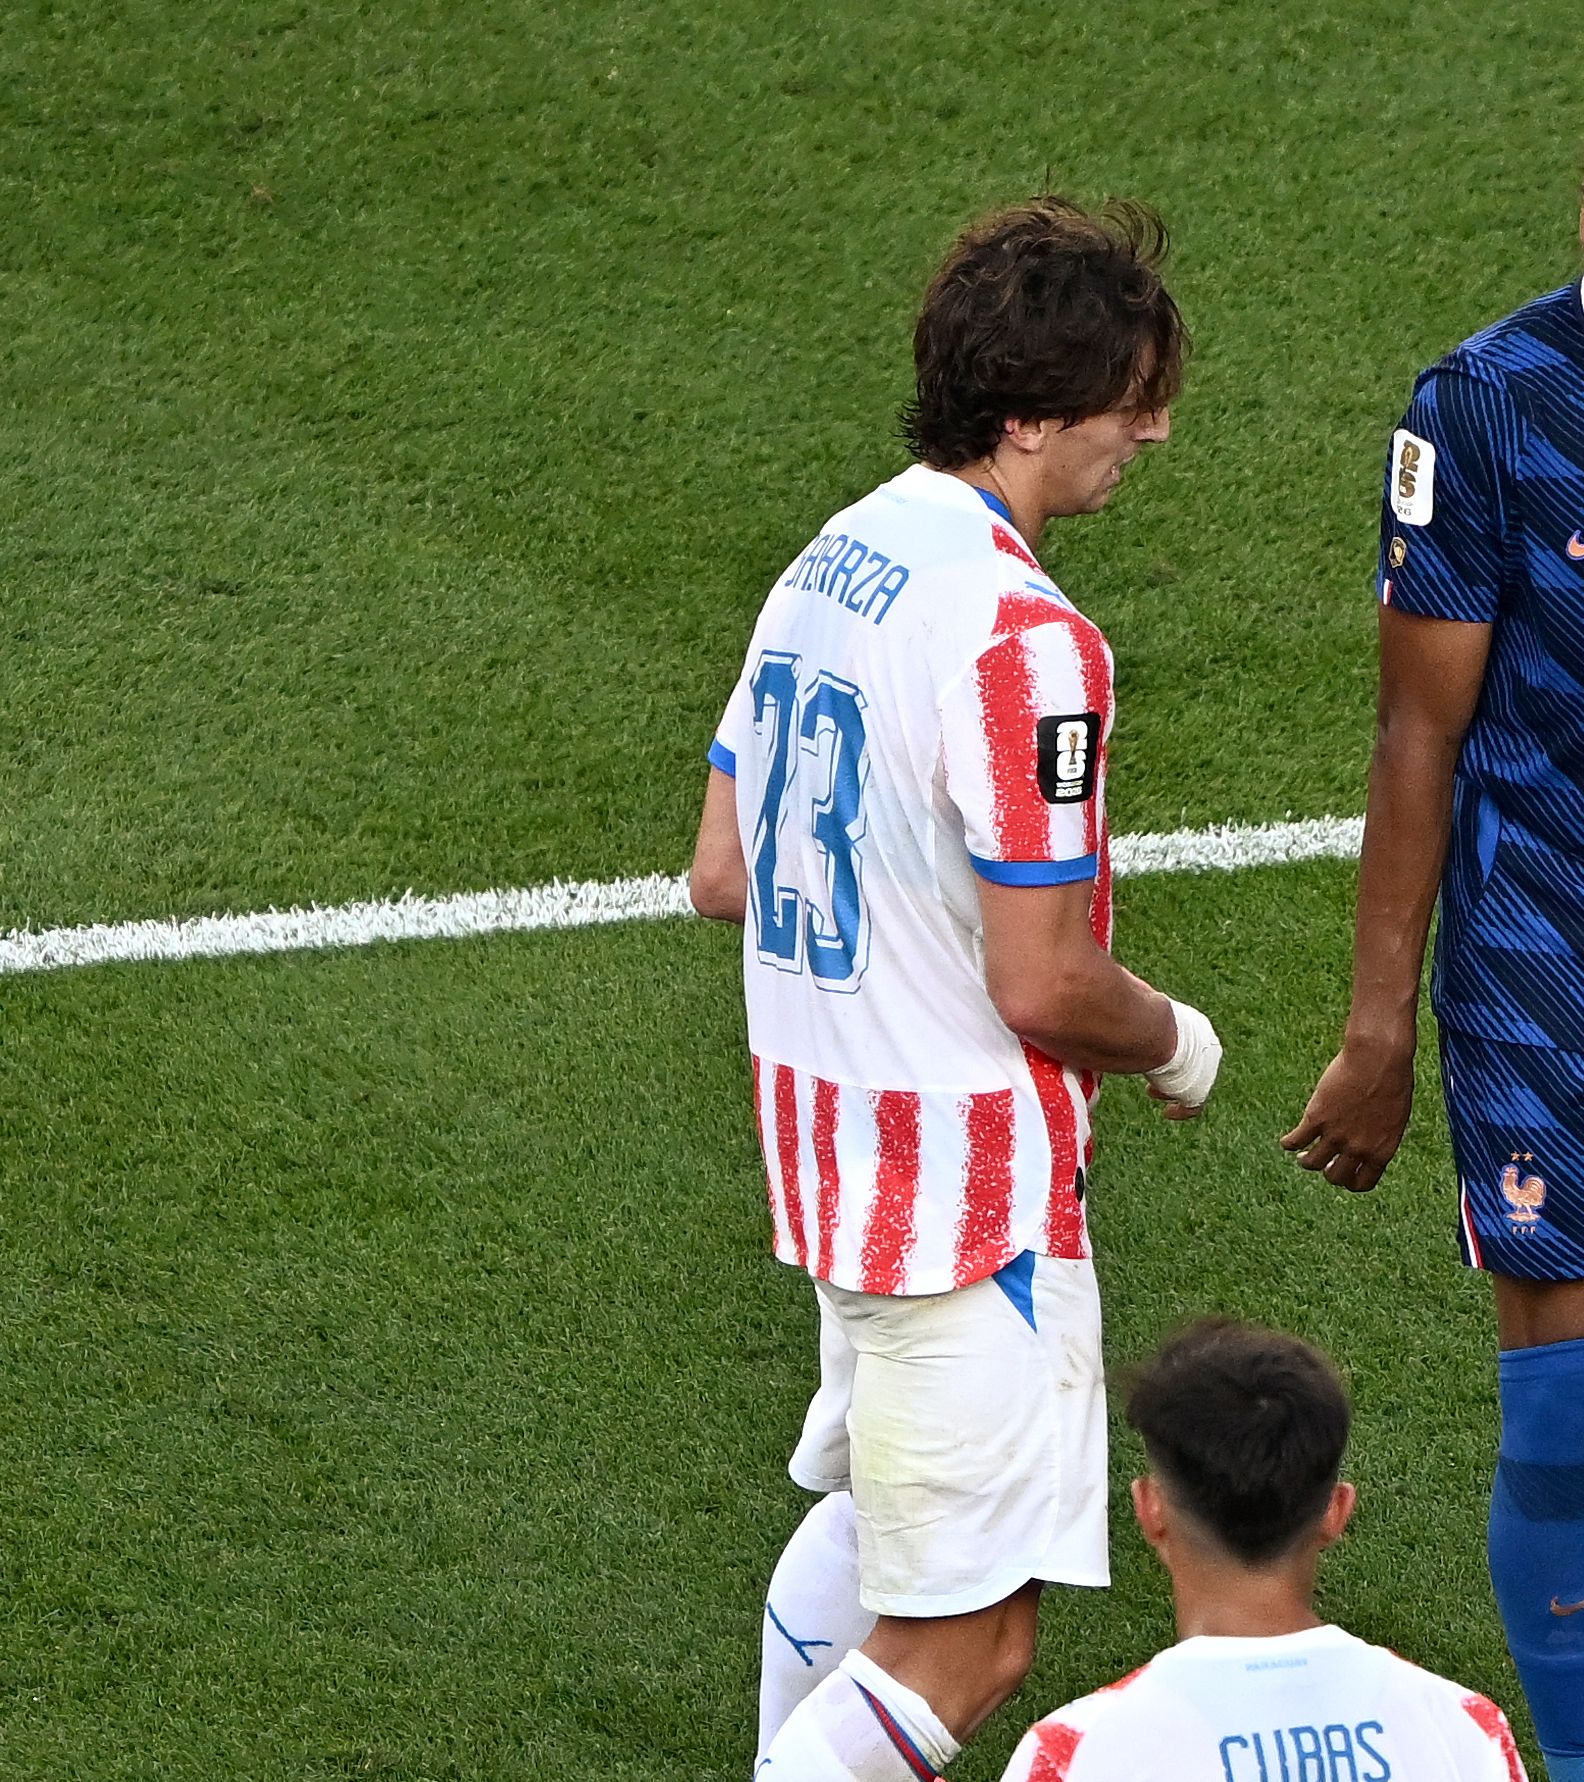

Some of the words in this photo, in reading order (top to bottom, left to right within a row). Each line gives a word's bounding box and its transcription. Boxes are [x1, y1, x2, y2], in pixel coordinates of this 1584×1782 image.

[749, 649, 871, 994] 23
[1512, 1225, 1536, 1236] FFF
[1219, 1720, 1392, 1782] CUBAS
